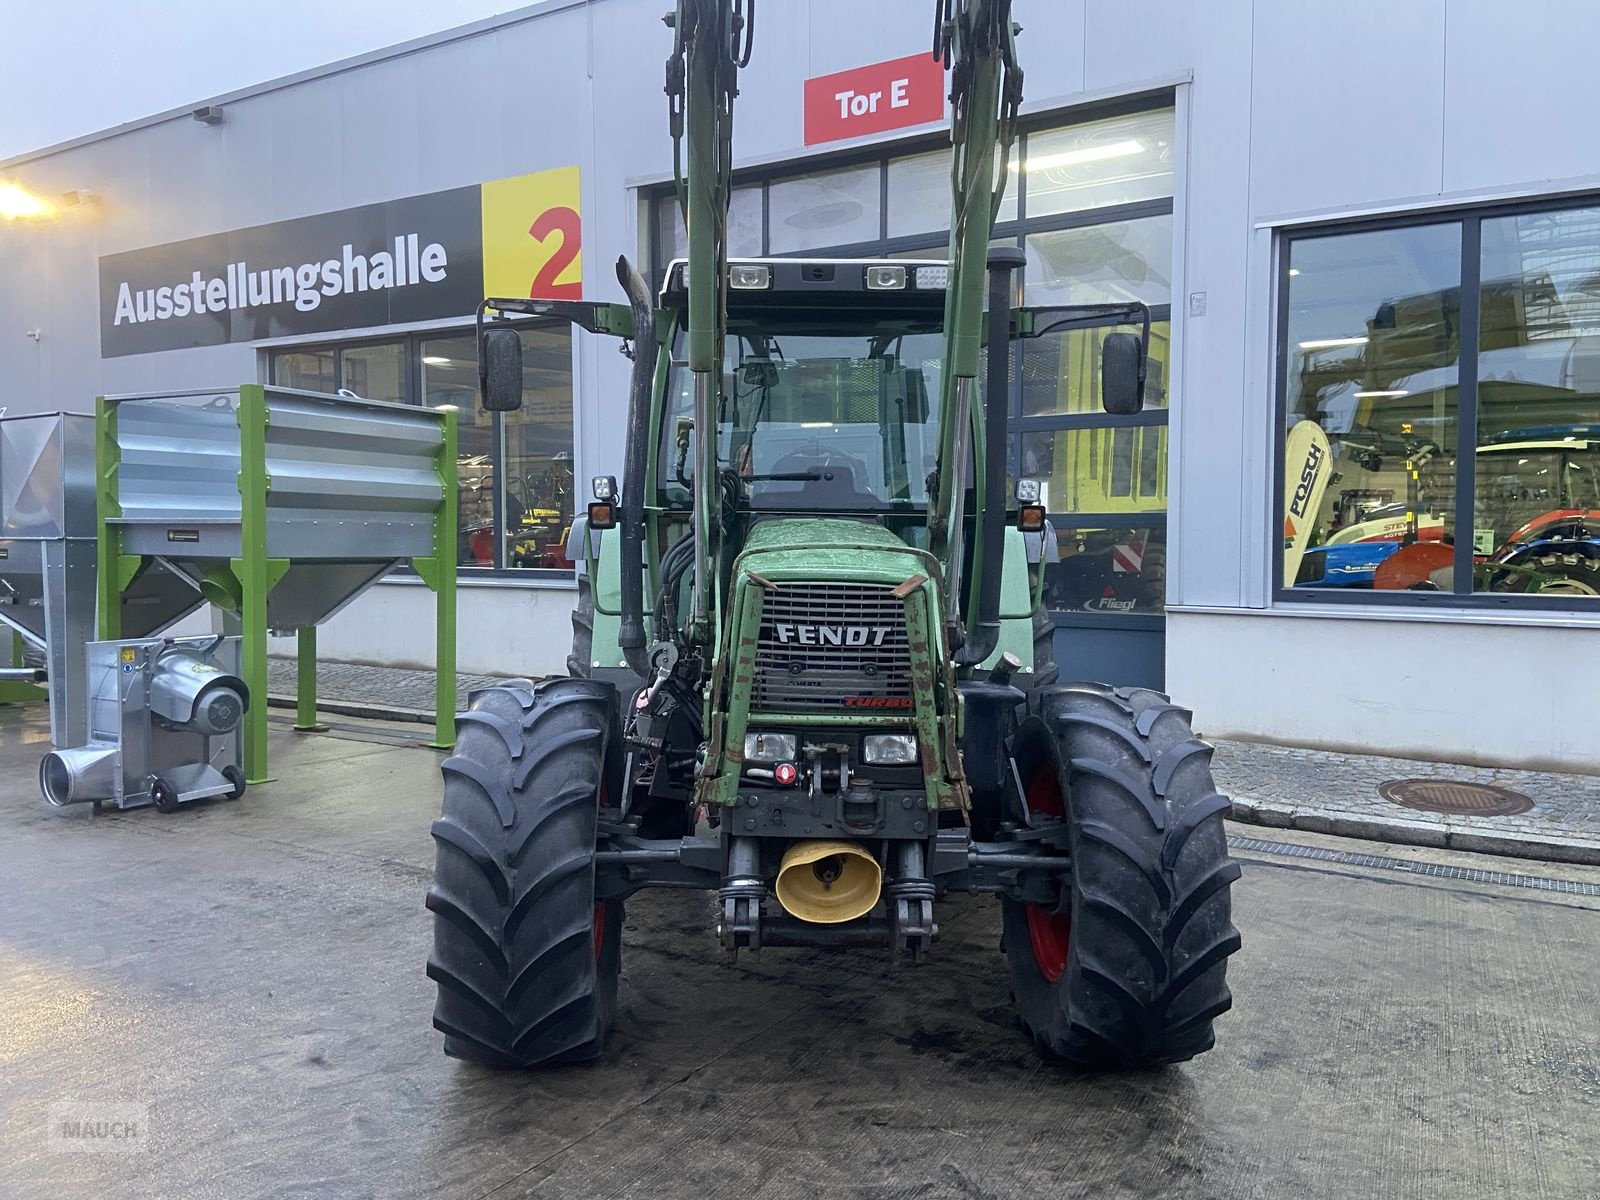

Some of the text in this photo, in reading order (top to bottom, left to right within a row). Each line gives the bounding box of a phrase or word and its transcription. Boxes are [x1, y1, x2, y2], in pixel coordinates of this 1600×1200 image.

[834, 78, 909, 119] Tor E
[114, 206, 582, 326] Ausstellungshalle 2
[1289, 442, 1322, 518] POSCH
[1098, 597, 1137, 613] Fliegl
[776, 623, 892, 646] FENDT
[844, 696, 914, 708] TURBO
